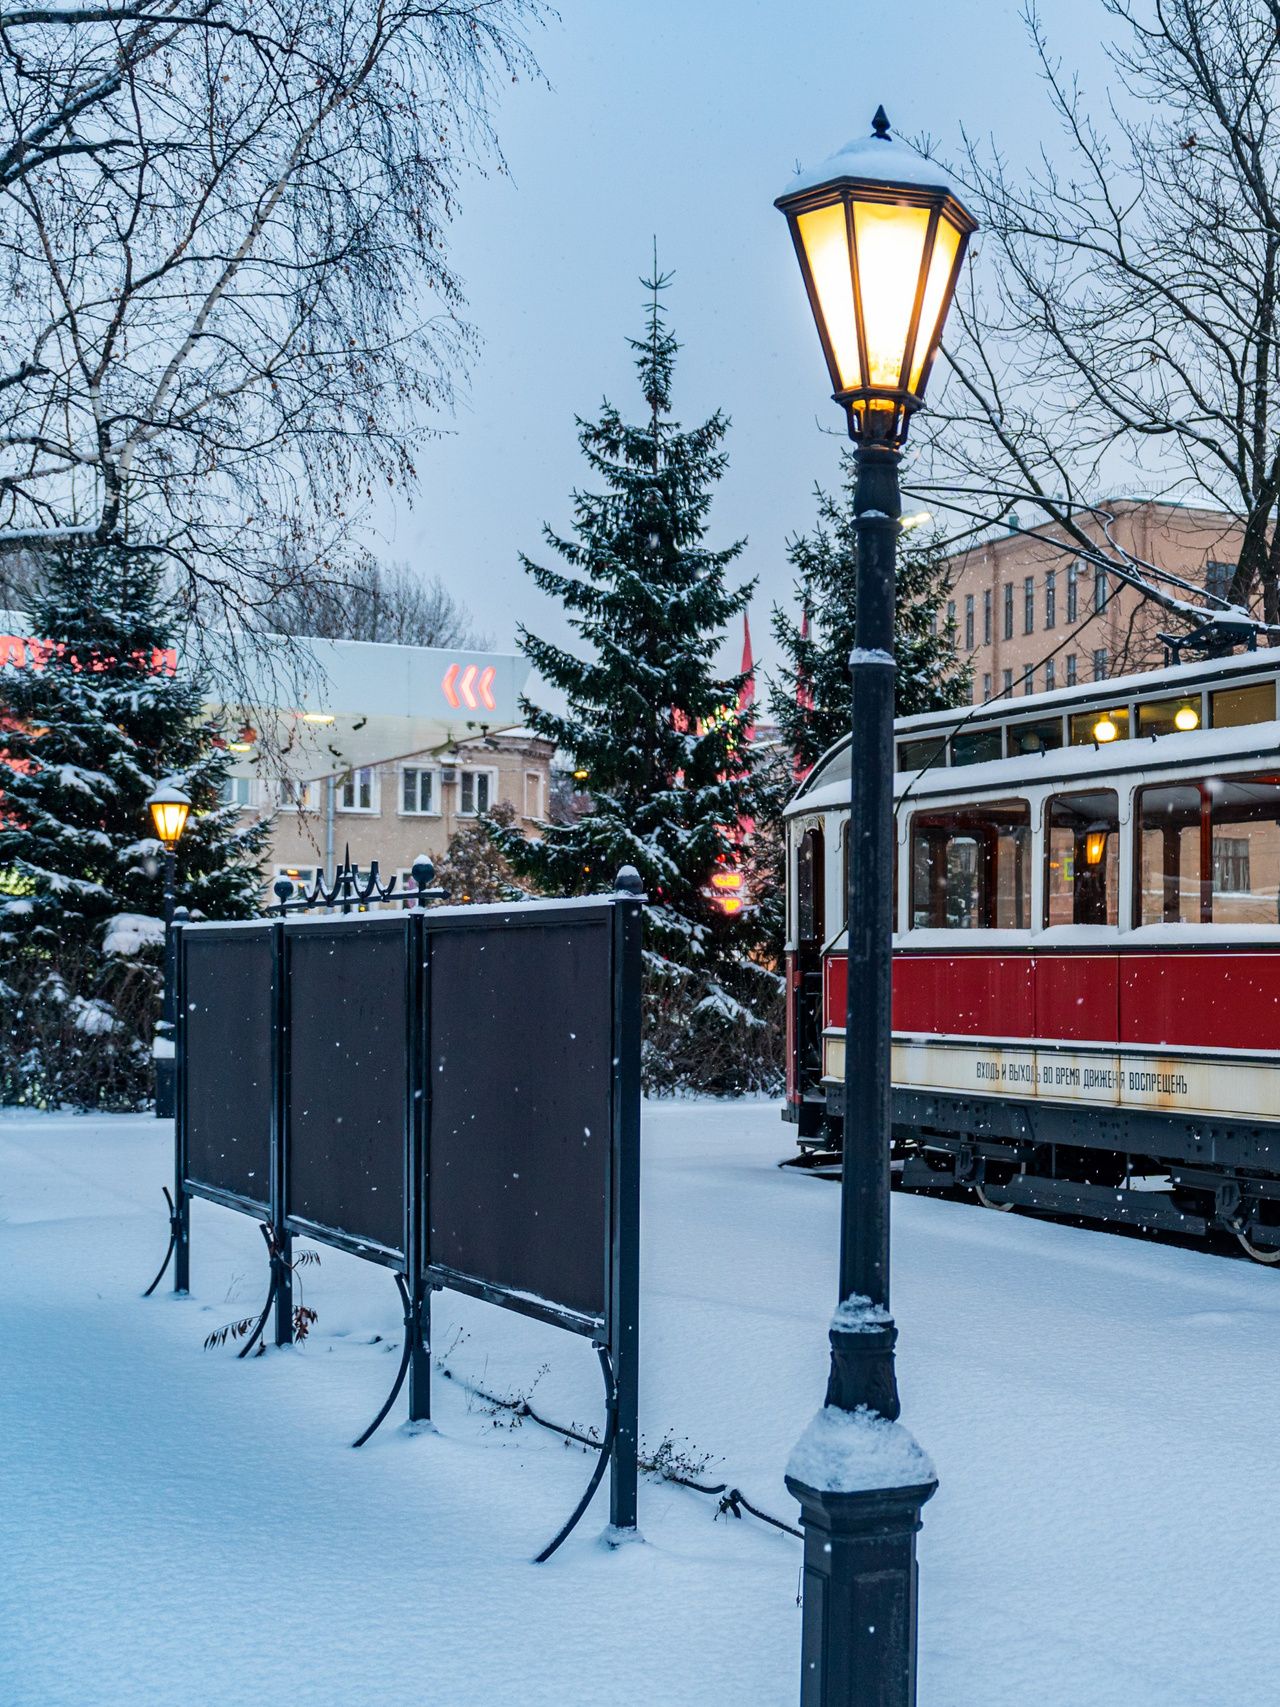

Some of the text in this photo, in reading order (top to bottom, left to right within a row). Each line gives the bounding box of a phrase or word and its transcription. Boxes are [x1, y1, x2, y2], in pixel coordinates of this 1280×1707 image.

[1001, 1063, 1007, 1080] И
[1043, 1066, 1053, 1084] ВО
[1055, 1067, 1081, 1086] ВРЕМЯ
[1129, 1072, 1188, 1095] ВОСПРЕЩЕНЪ
